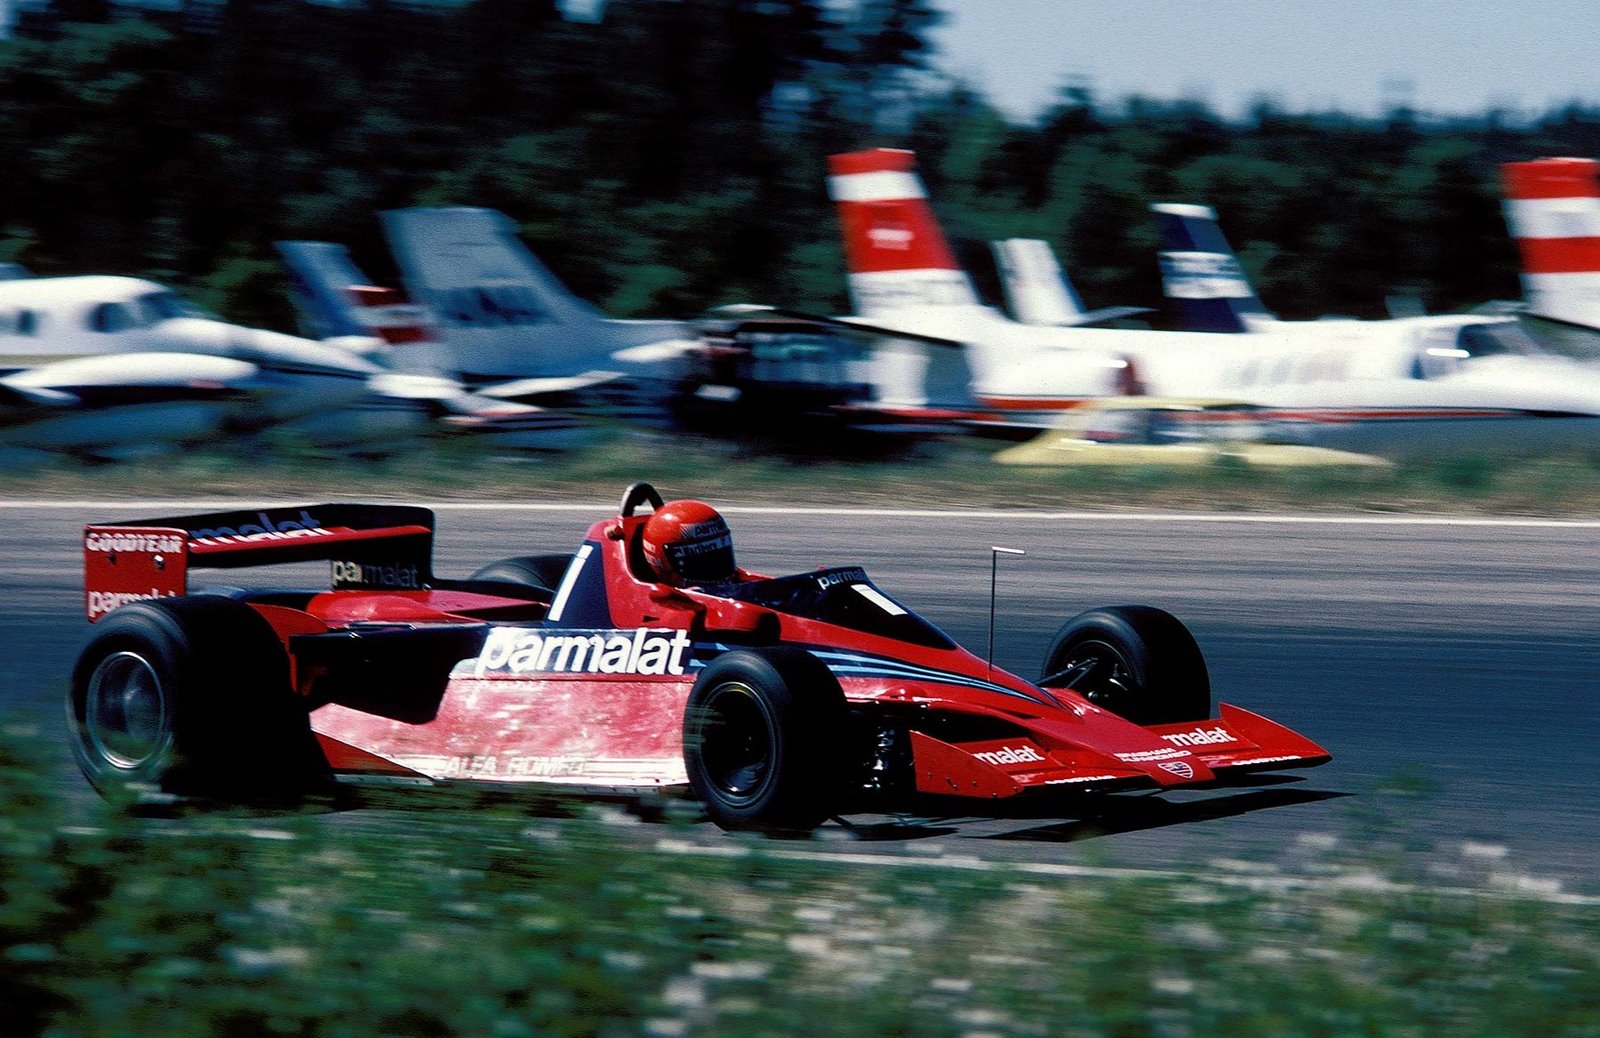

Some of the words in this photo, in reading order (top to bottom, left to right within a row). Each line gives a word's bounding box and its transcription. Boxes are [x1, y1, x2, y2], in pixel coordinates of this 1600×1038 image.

[86, 532, 183, 554] GOODYEAR
[188, 511, 334, 548] malat
[473, 627, 691, 678] parmalat
[1160, 726, 1238, 747] malat
